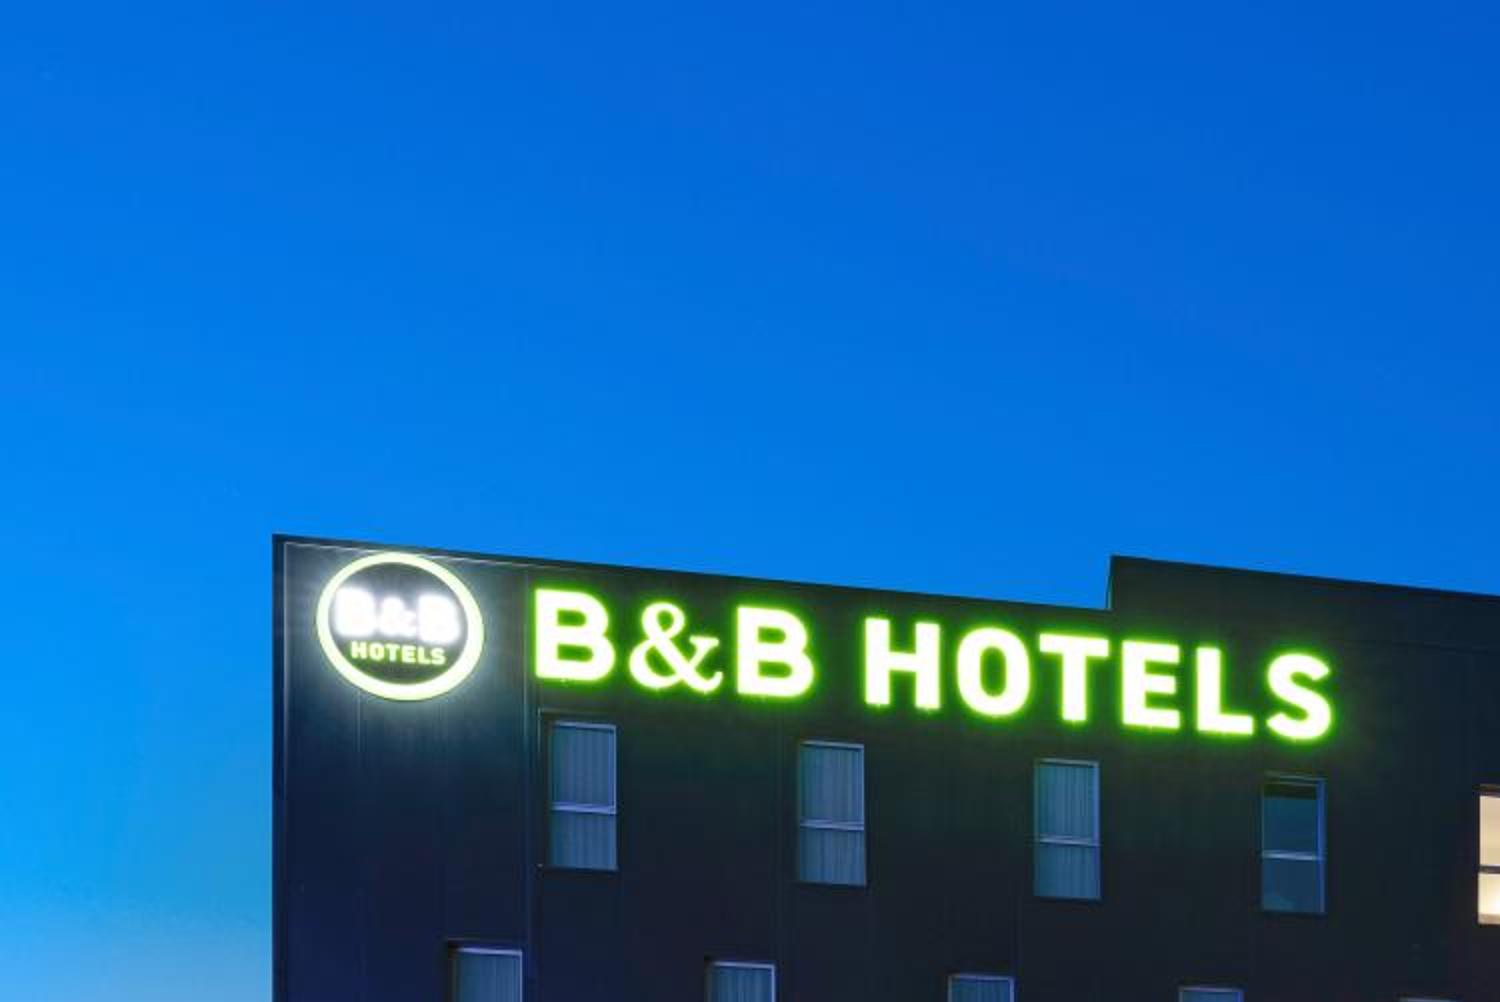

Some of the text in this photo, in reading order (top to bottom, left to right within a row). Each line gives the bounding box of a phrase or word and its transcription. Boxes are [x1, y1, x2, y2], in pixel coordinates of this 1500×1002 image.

[333, 586, 462, 644] B&B
[350, 640, 446, 667] HOTELS
[535, 588, 1331, 742] B&B HOTELS
